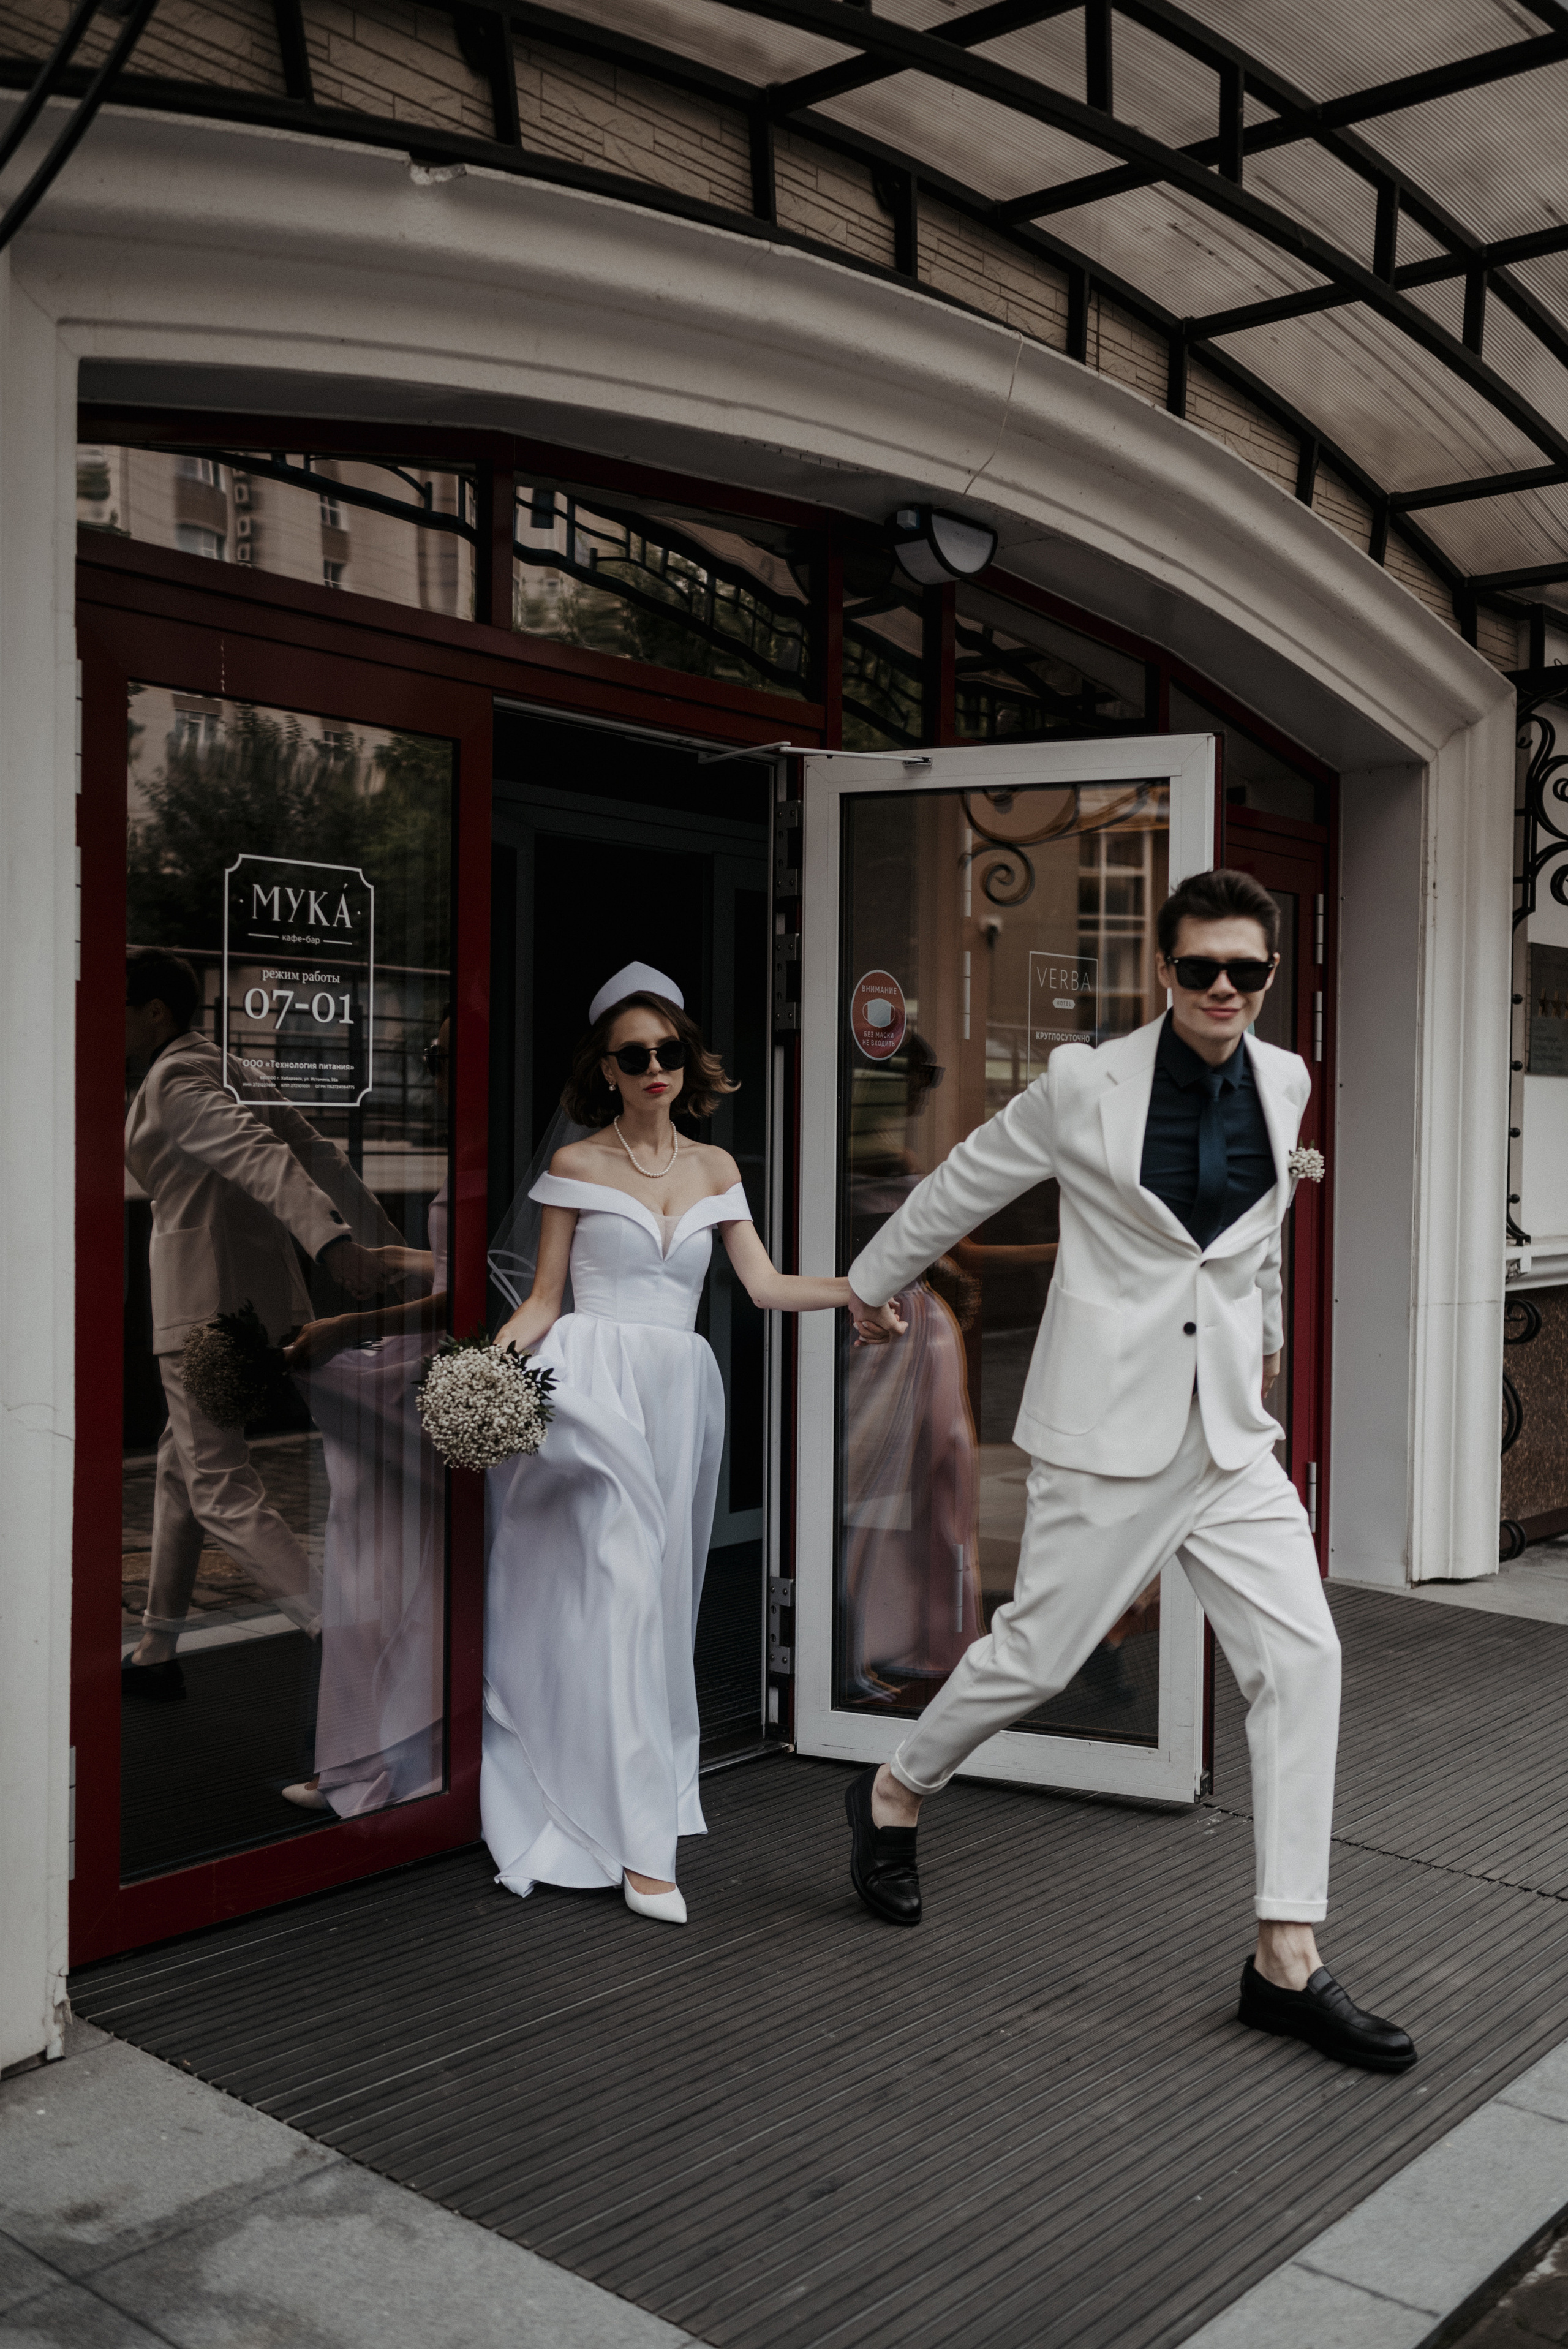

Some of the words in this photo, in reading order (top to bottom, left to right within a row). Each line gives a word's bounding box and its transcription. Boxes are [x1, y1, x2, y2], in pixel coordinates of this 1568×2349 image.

[282, 933, 320, 945] кафе-бар
[262, 968, 300, 981] режим
[302, 970, 341, 984] работы
[1037, 967, 1091, 992] VERBA
[862, 984, 897, 995] ВНИМАНИЕ
[244, 987, 354, 1030] 07-01
[1036, 1031, 1090, 1043] КРУГЛОСУТОЧНО
[871, 1039, 895, 1048] ВХОДИТЬ
[243, 1059, 263, 1068] ООО
[265, 1060, 317, 1069] «Технология
